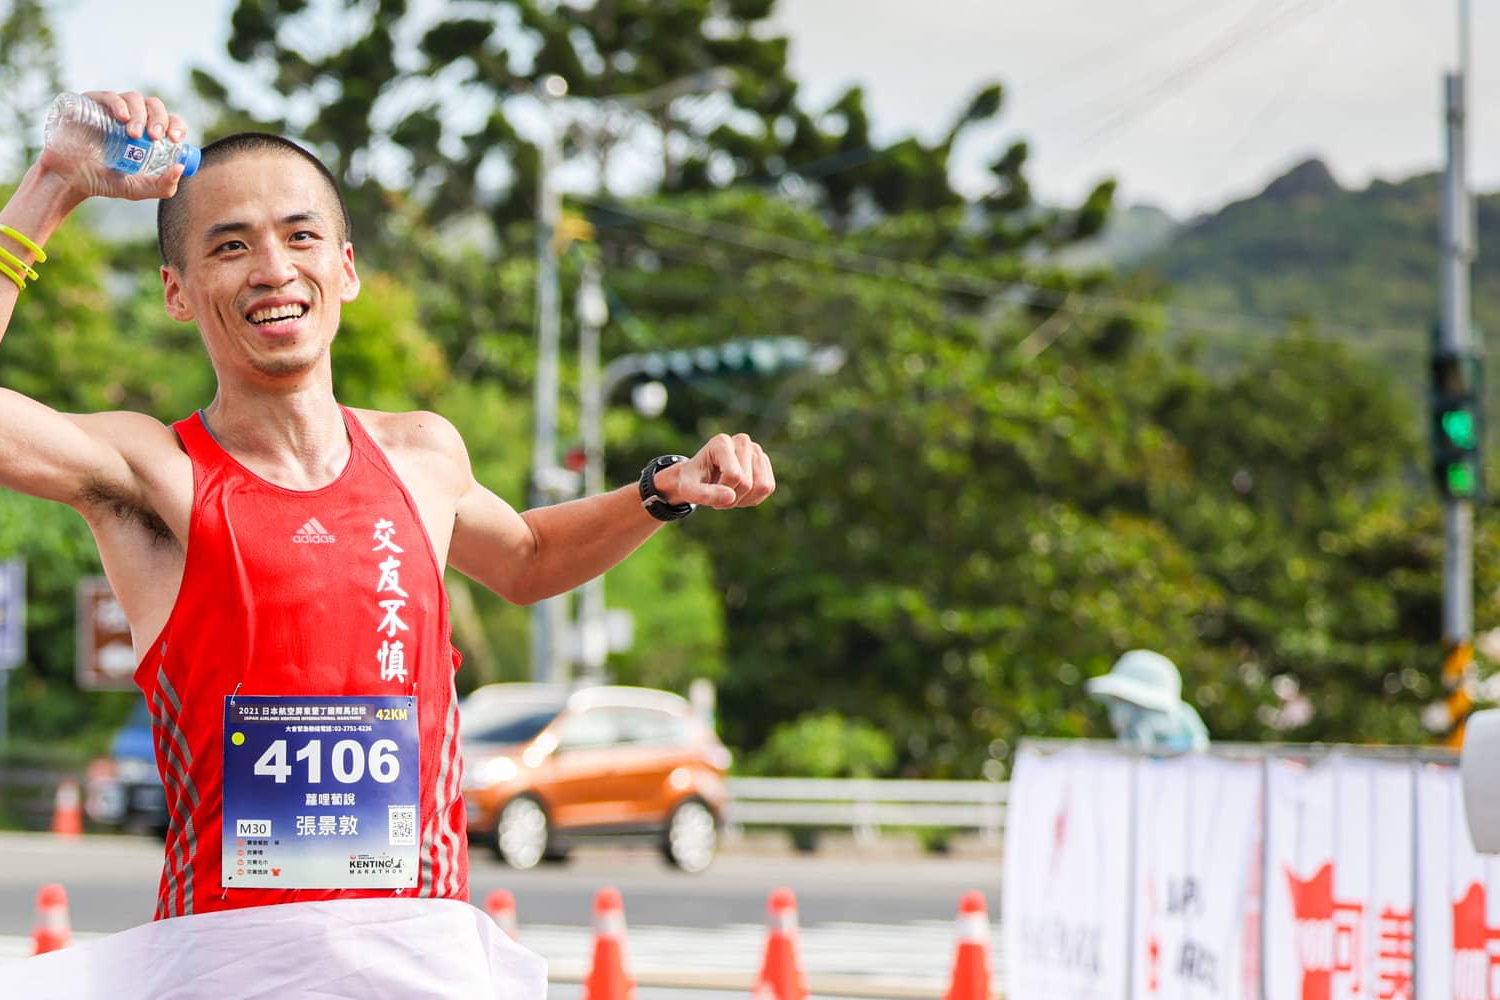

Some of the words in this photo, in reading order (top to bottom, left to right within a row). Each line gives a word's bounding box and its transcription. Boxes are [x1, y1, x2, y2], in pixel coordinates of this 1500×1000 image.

[292, 533, 336, 544] adidas
[371, 518, 410, 684] 交友不慎
[238, 707, 260, 715] 2021
[375, 709, 408, 721] 42KM
[253, 739, 400, 784] 4106
[240, 823, 267, 834] M30
[296, 815, 359, 836] 張景敦
[349, 860, 392, 868] KENTING
